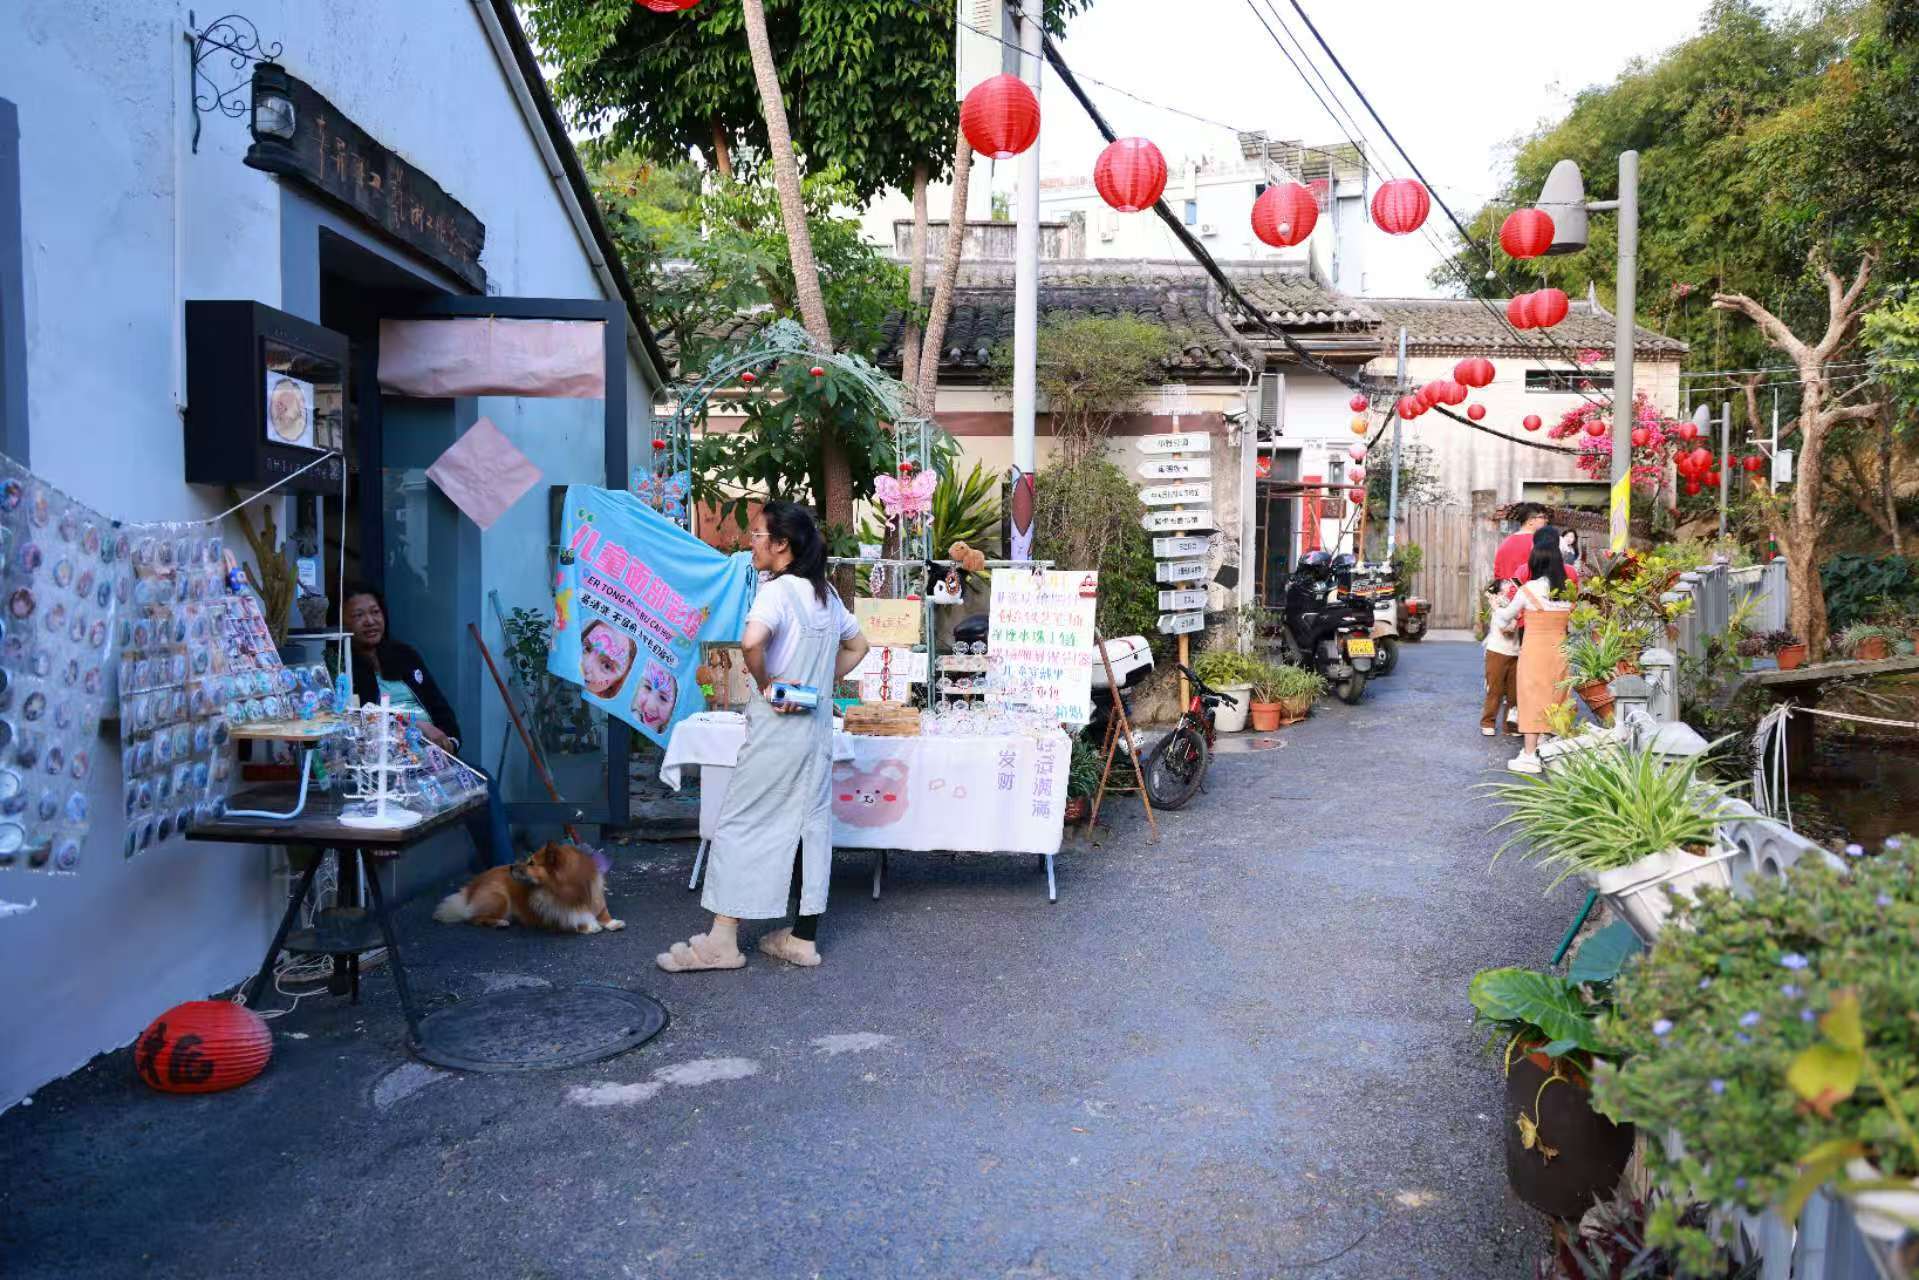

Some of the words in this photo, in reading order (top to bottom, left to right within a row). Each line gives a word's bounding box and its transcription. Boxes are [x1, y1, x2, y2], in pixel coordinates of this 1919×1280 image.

[571, 524, 704, 640] 儿童面部彩绘
[587, 576, 601, 589] ER
[601, 584, 626, 603] TONG
[649, 620, 662, 632] CAI
[998, 750, 1017, 791] 发财
